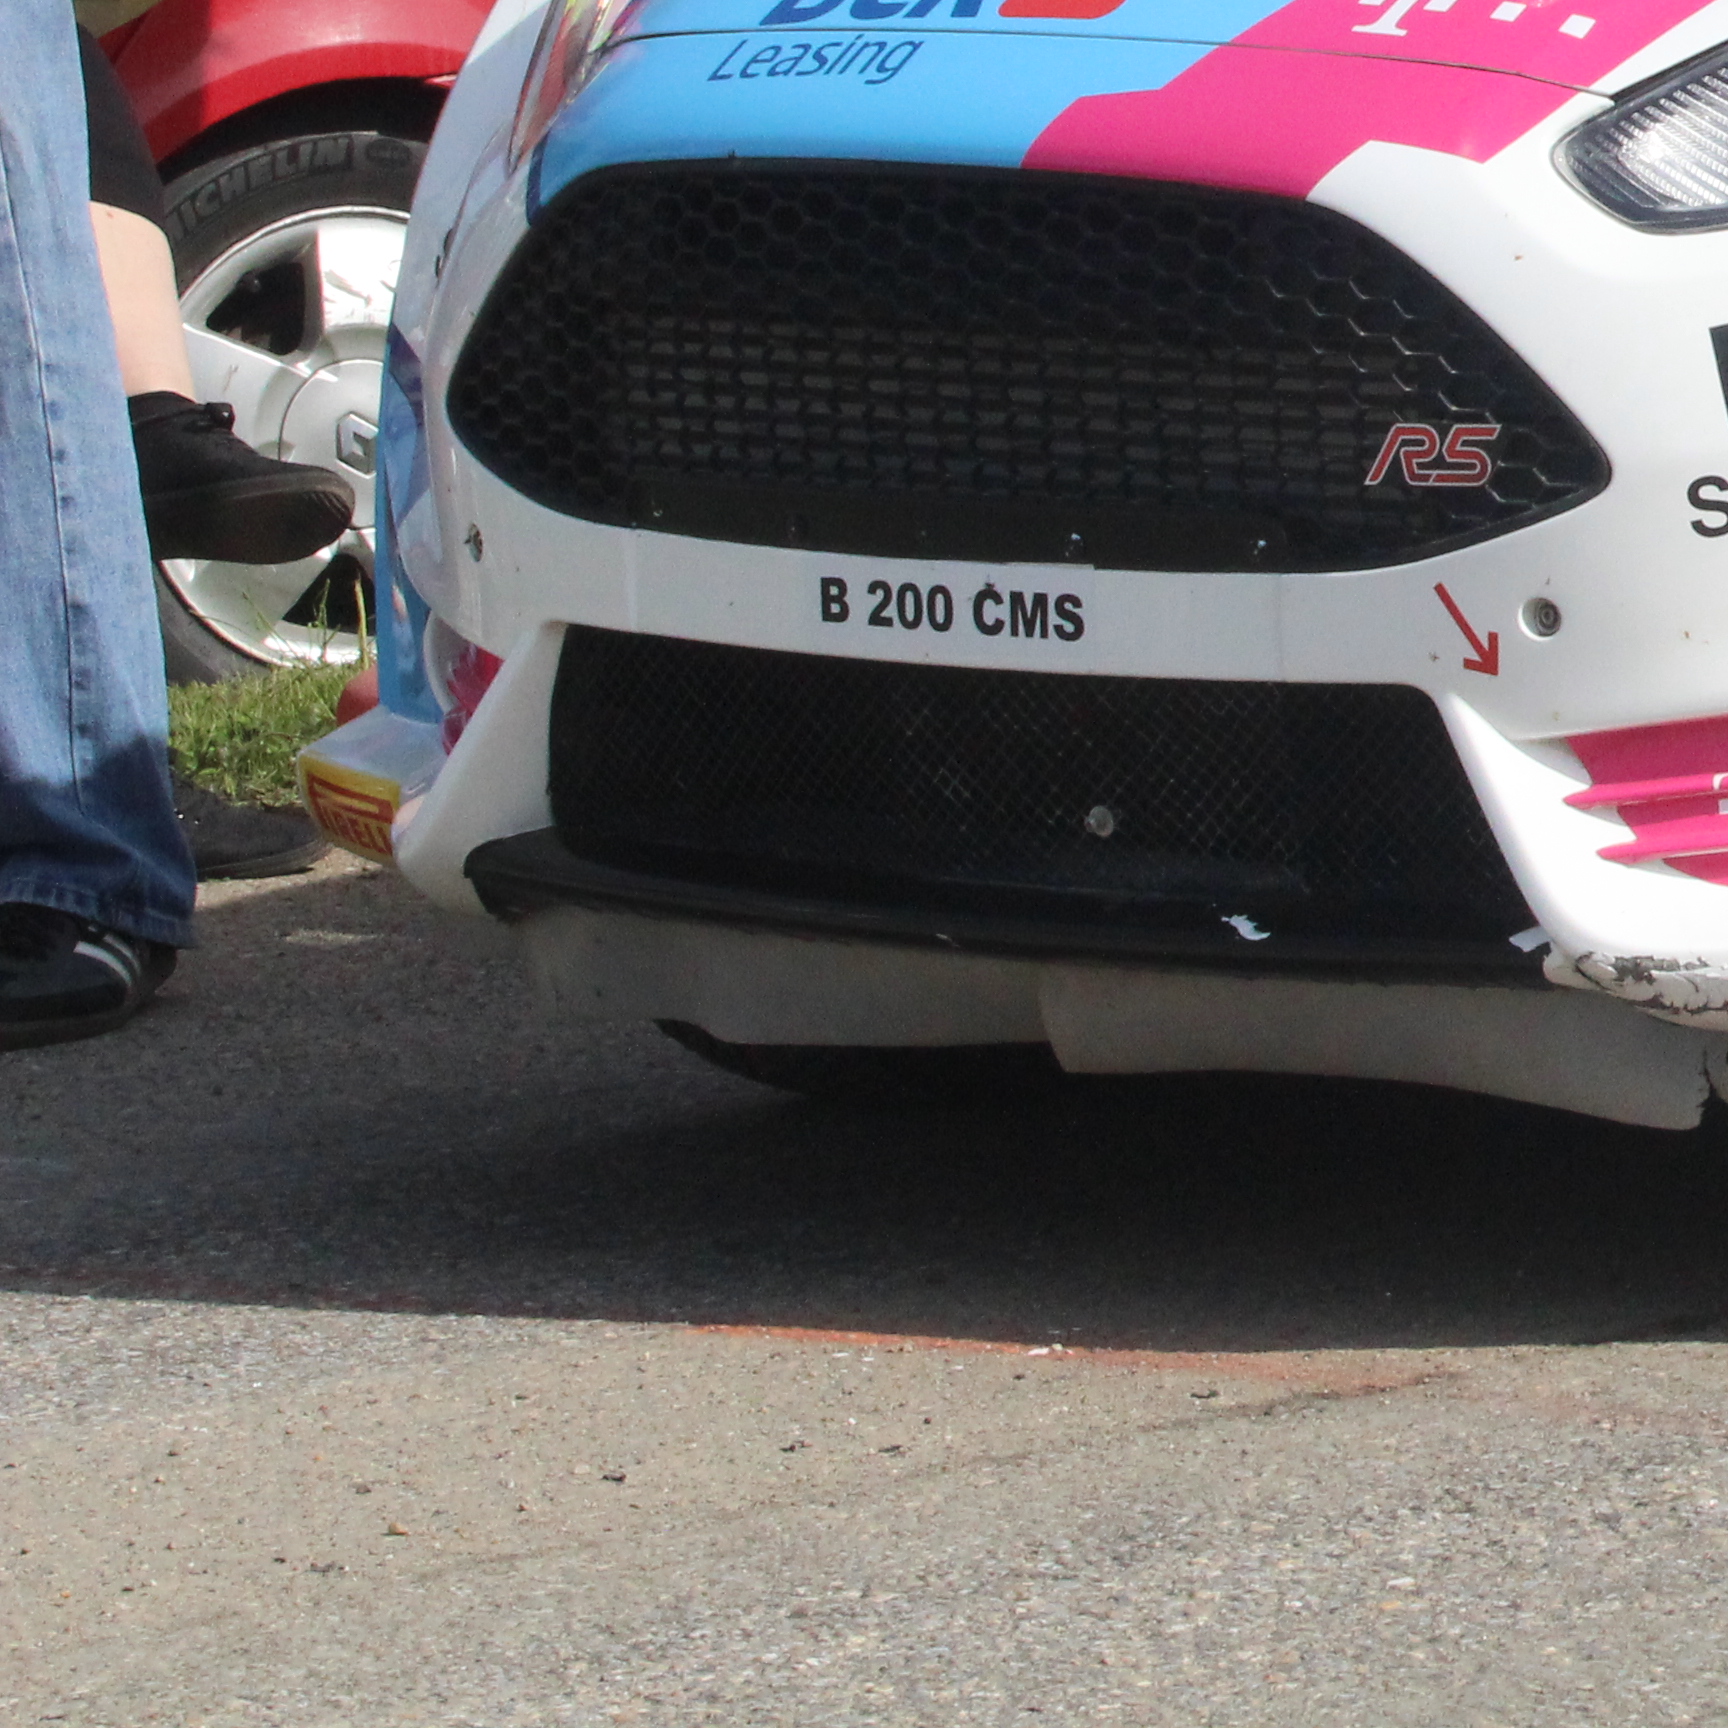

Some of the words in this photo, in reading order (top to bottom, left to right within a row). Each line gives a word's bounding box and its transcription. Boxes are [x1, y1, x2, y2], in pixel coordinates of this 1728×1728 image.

[706, 32, 925, 86] Leasing
[1363, 422, 1502, 487] RS
[820, 576, 850, 623] B
[866, 579, 955, 633] 200
